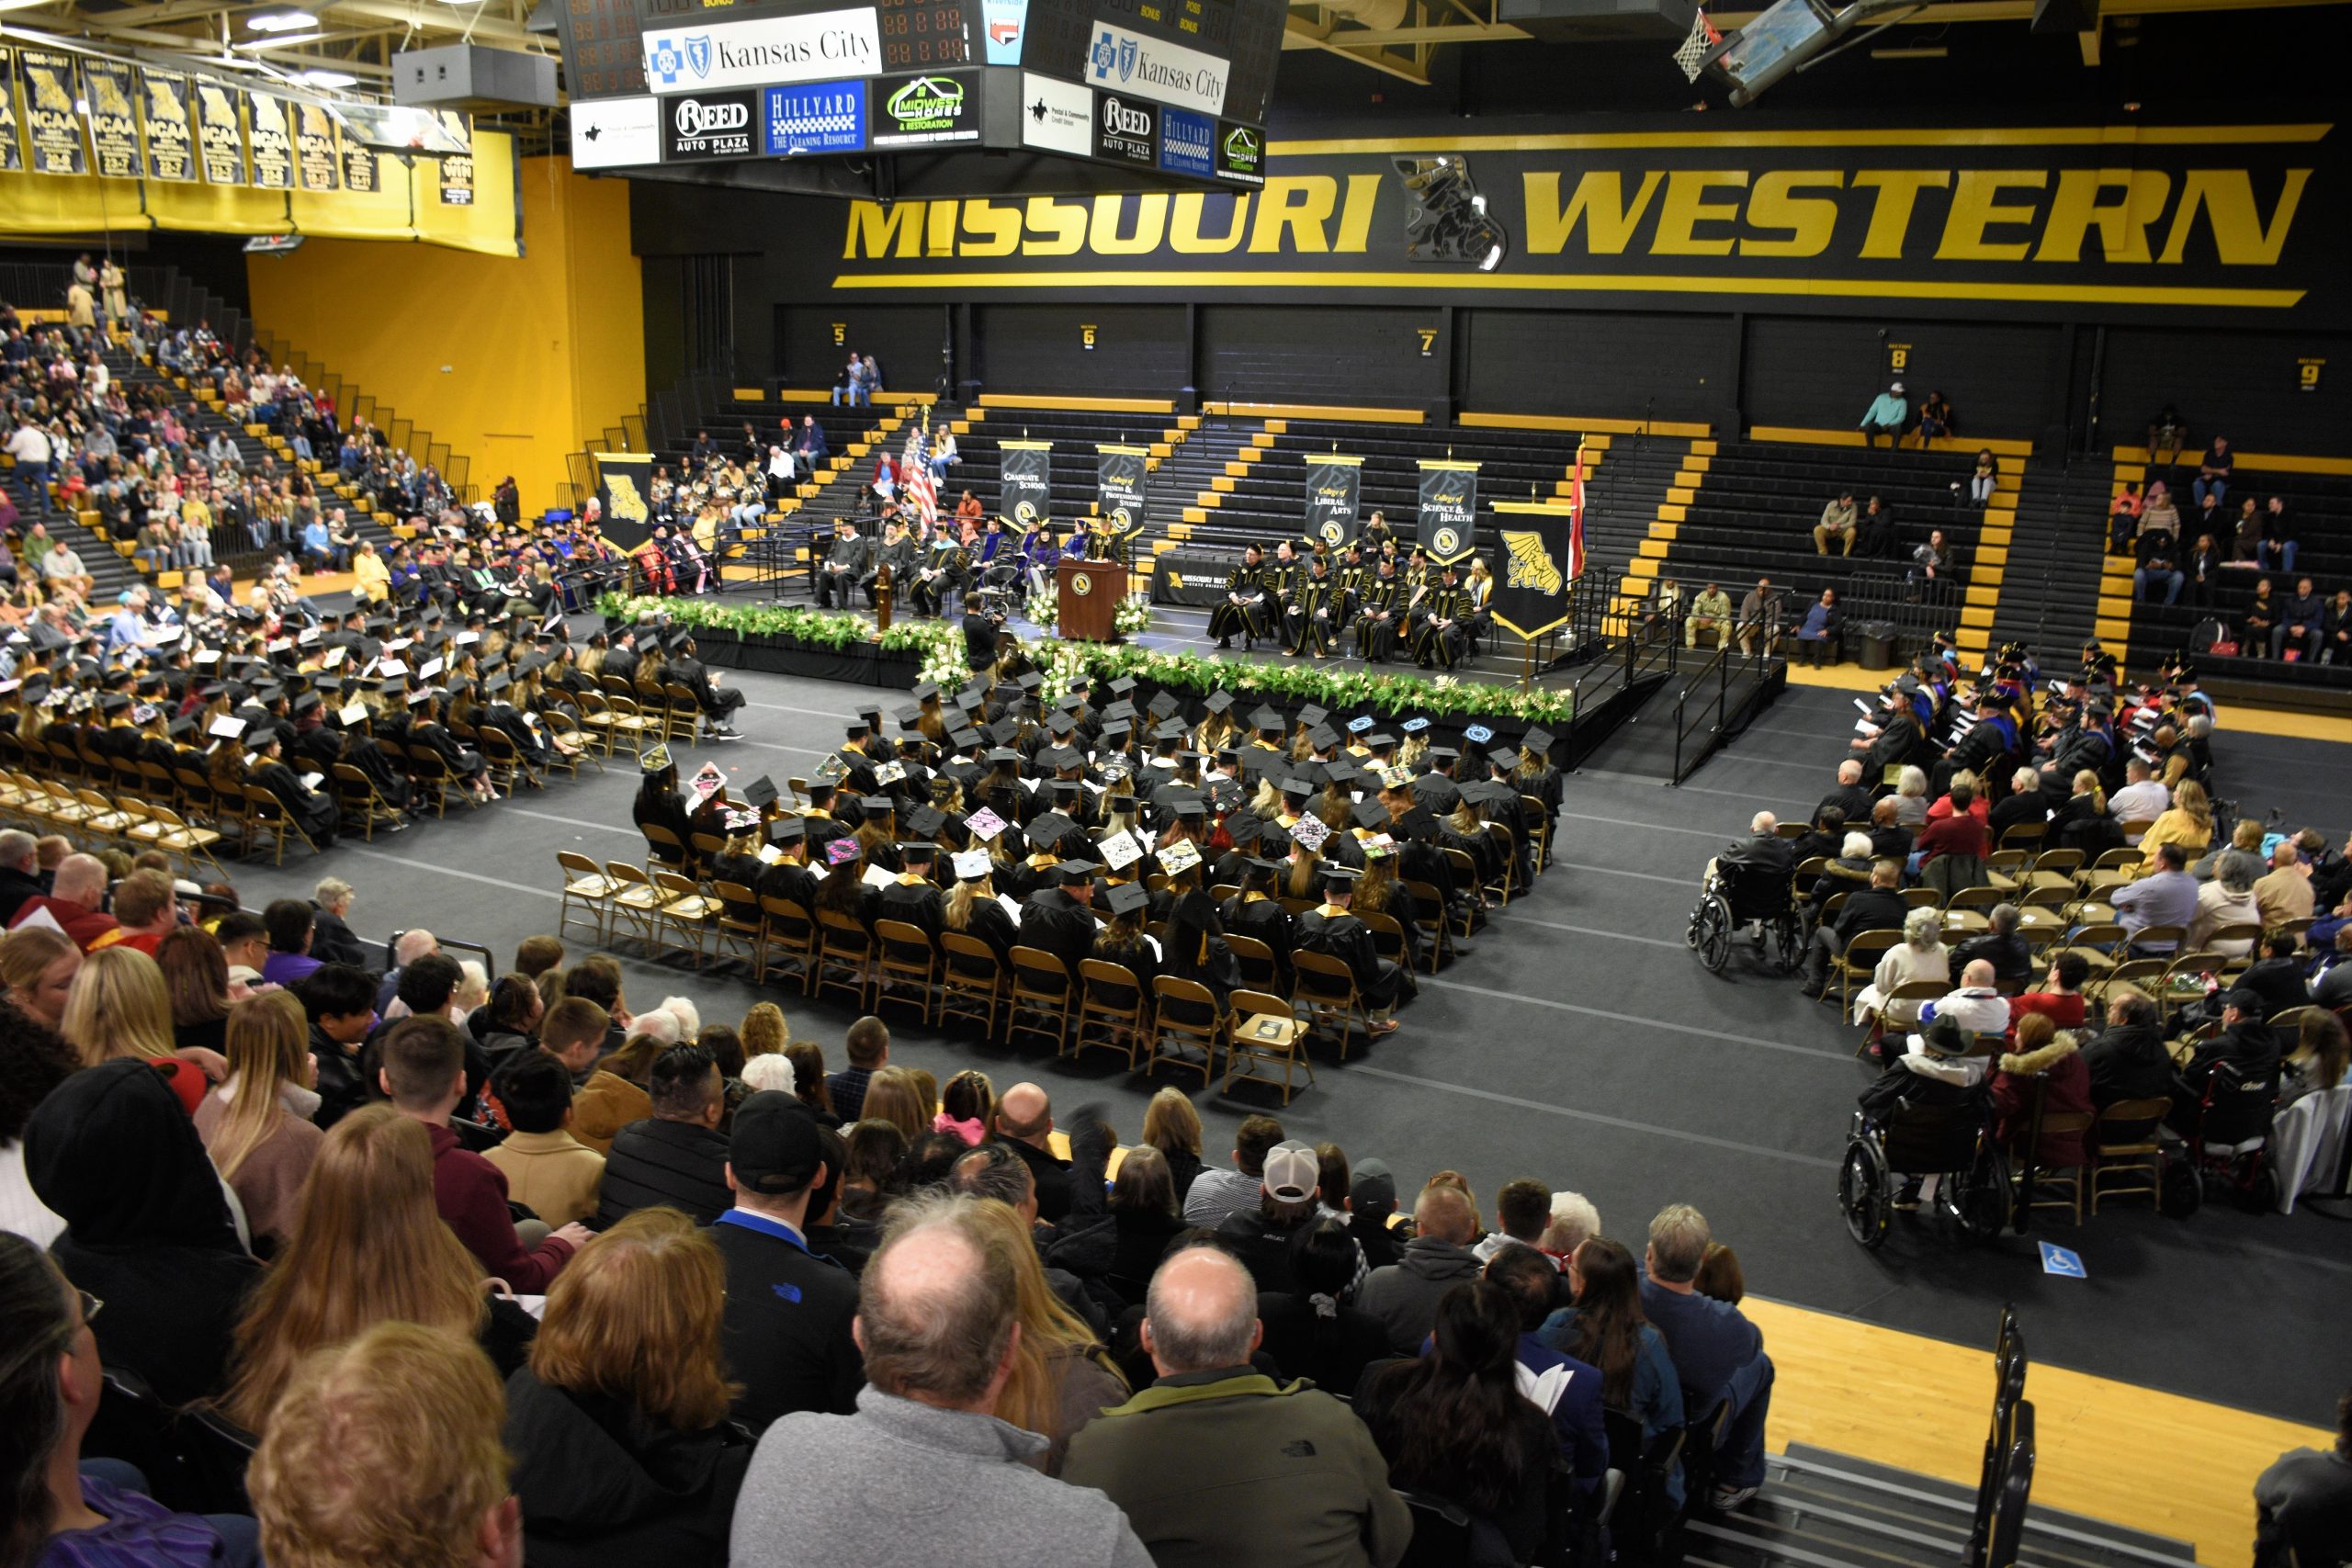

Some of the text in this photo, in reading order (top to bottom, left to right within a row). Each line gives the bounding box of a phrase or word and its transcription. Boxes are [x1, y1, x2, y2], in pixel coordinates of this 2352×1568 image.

[1140, 5, 1160, 22] BONUS
[1180, 17, 1199, 34] BONUS
[718, 29, 872, 70] Kansas City
[1137, 51, 1225, 106] Kansas City
[773, 94, 855, 118] HILLYARD
[899, 96, 964, 112] MIDWEST
[914, 106, 962, 118] HOMES
[27, 109, 80, 130] NCAA
[91, 115, 138, 135] NCAA
[676, 100, 749, 136] REED
[899, 119, 953, 131] & RESTORATION
[1104, 98, 1150, 136] REED
[144, 119, 191, 140] NCAA
[200, 126, 242, 146] NCAA
[1165, 115, 1209, 145] HILLYARD
[249, 130, 291, 151] NCAA
[296, 135, 335, 154] NCAA
[677, 137, 749, 152] AUTO PLAZA
[774, 137, 787, 149] THE
[1103, 138, 1149, 155] AUTO PLAZA
[842, 169, 2314, 265] MISSOURI WESTERN
[835, 328, 844, 342] 5
[1084, 330, 1094, 344] 6
[1422, 335, 1433, 350] 7
[1892, 350, 1906, 367] 8
[2301, 366, 2319, 384] 9
[1003, 472, 1039, 482] GRADUATE
[1019, 481, 1047, 490] SCHOOL
[1125, 485, 1132, 493] &
[1318, 487, 1348, 497] College of
[1315, 496, 1345, 506] LIBERAL
[1433, 493, 1464, 504] College of
[1330, 506, 1351, 515] ARTS
[1422, 502, 1464, 514] SCIENCE &
[1440, 512, 1473, 523] HEALTH
[1182, 574, 1212, 583] MISSOURI
